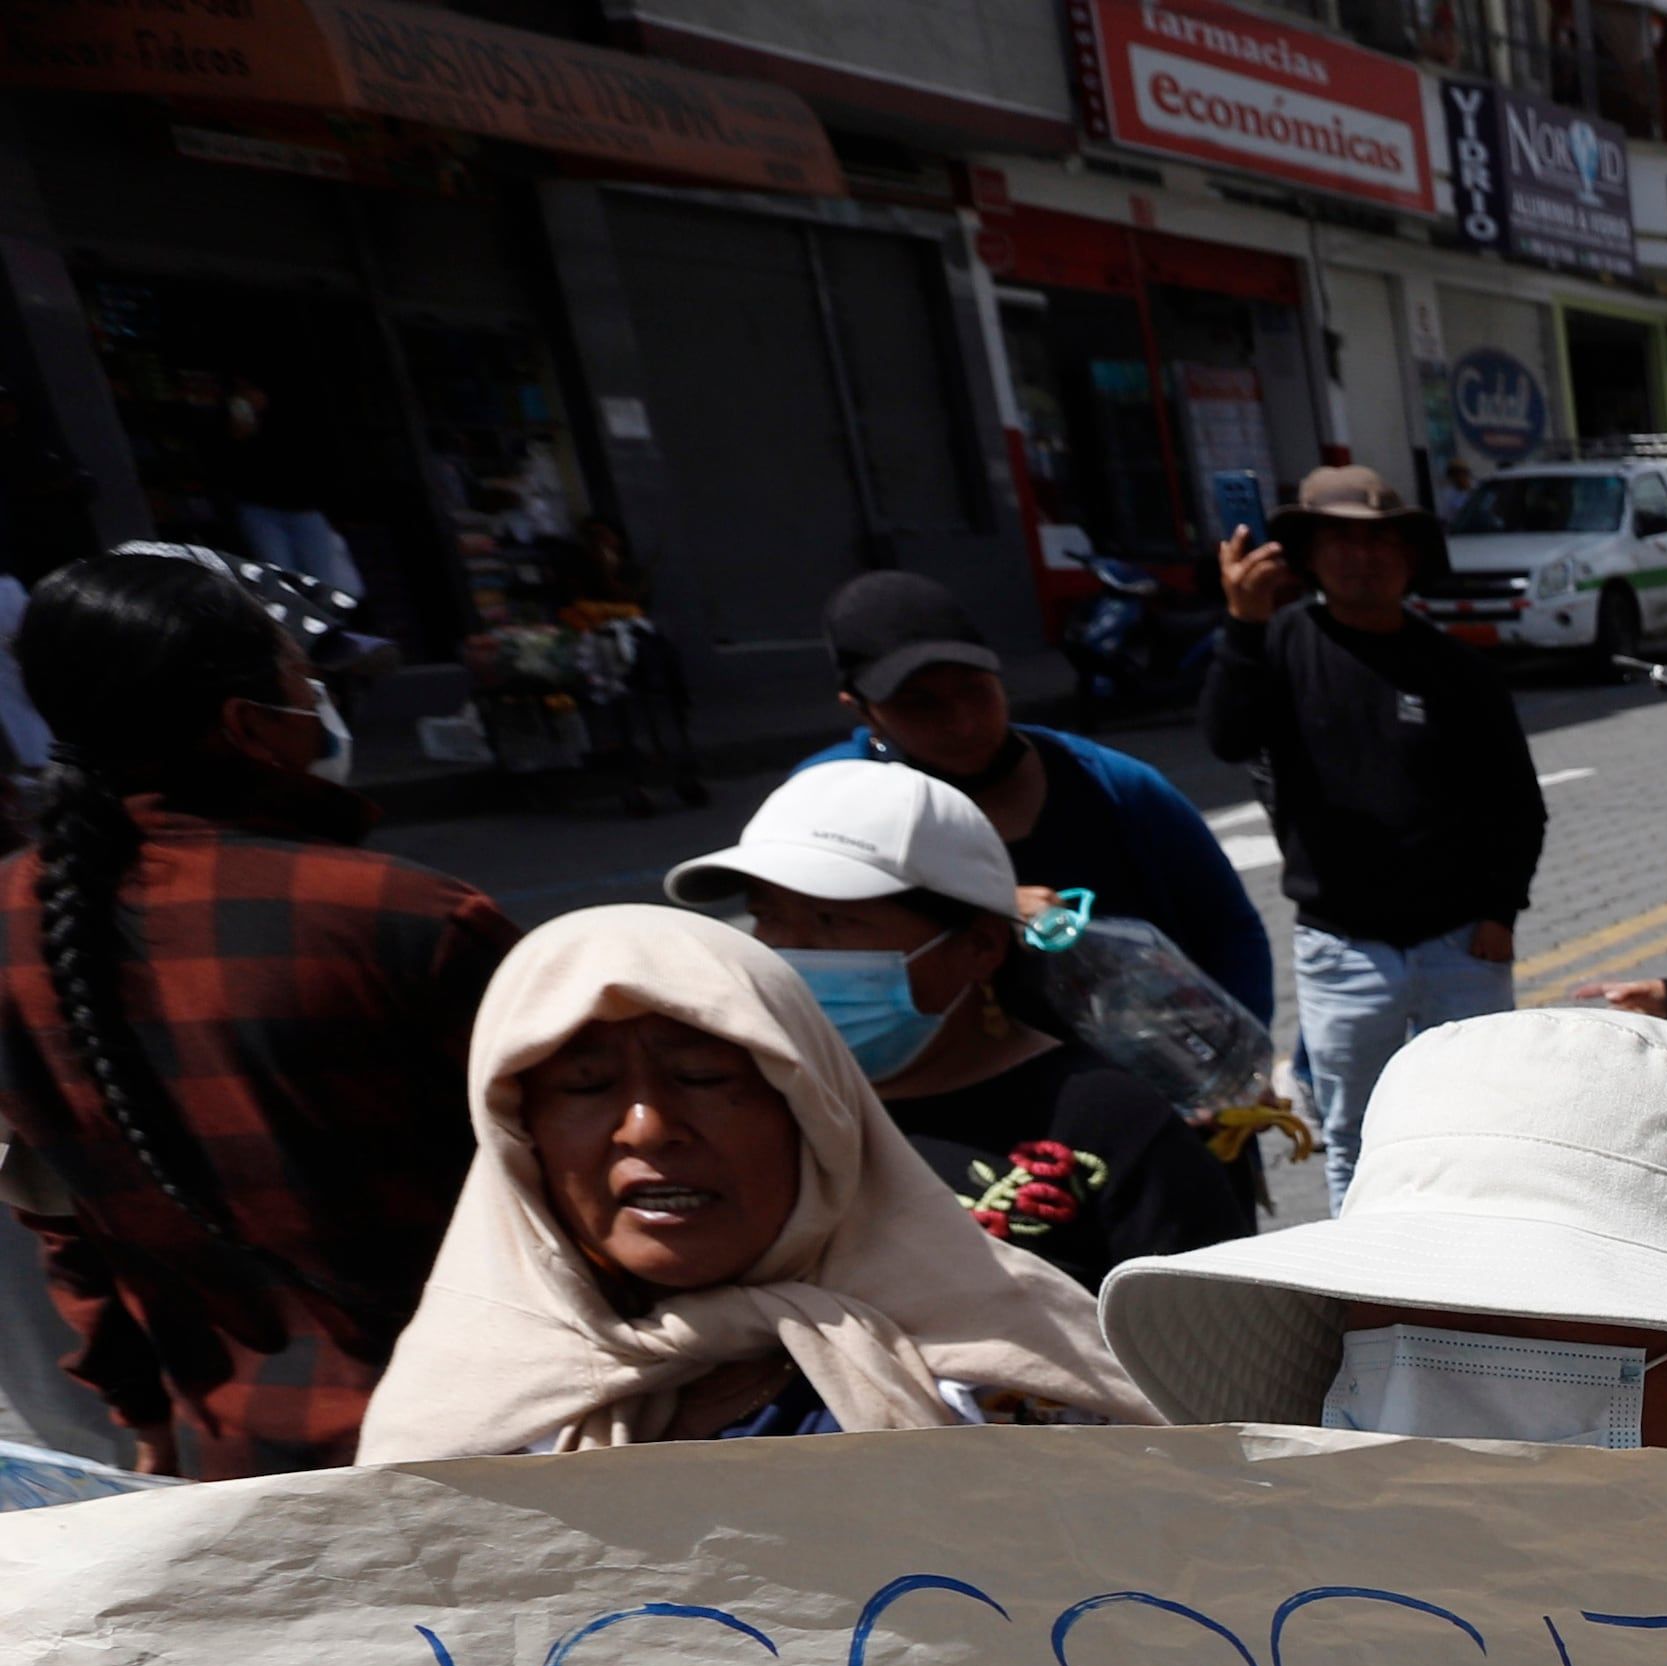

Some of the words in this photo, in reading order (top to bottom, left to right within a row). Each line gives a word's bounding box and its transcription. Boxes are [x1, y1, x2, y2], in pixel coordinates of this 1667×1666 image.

[1139, 0, 1331, 87] farmacias
[1150, 71, 1404, 174] económicas
[1449, 86, 1499, 242] VIDRIO
